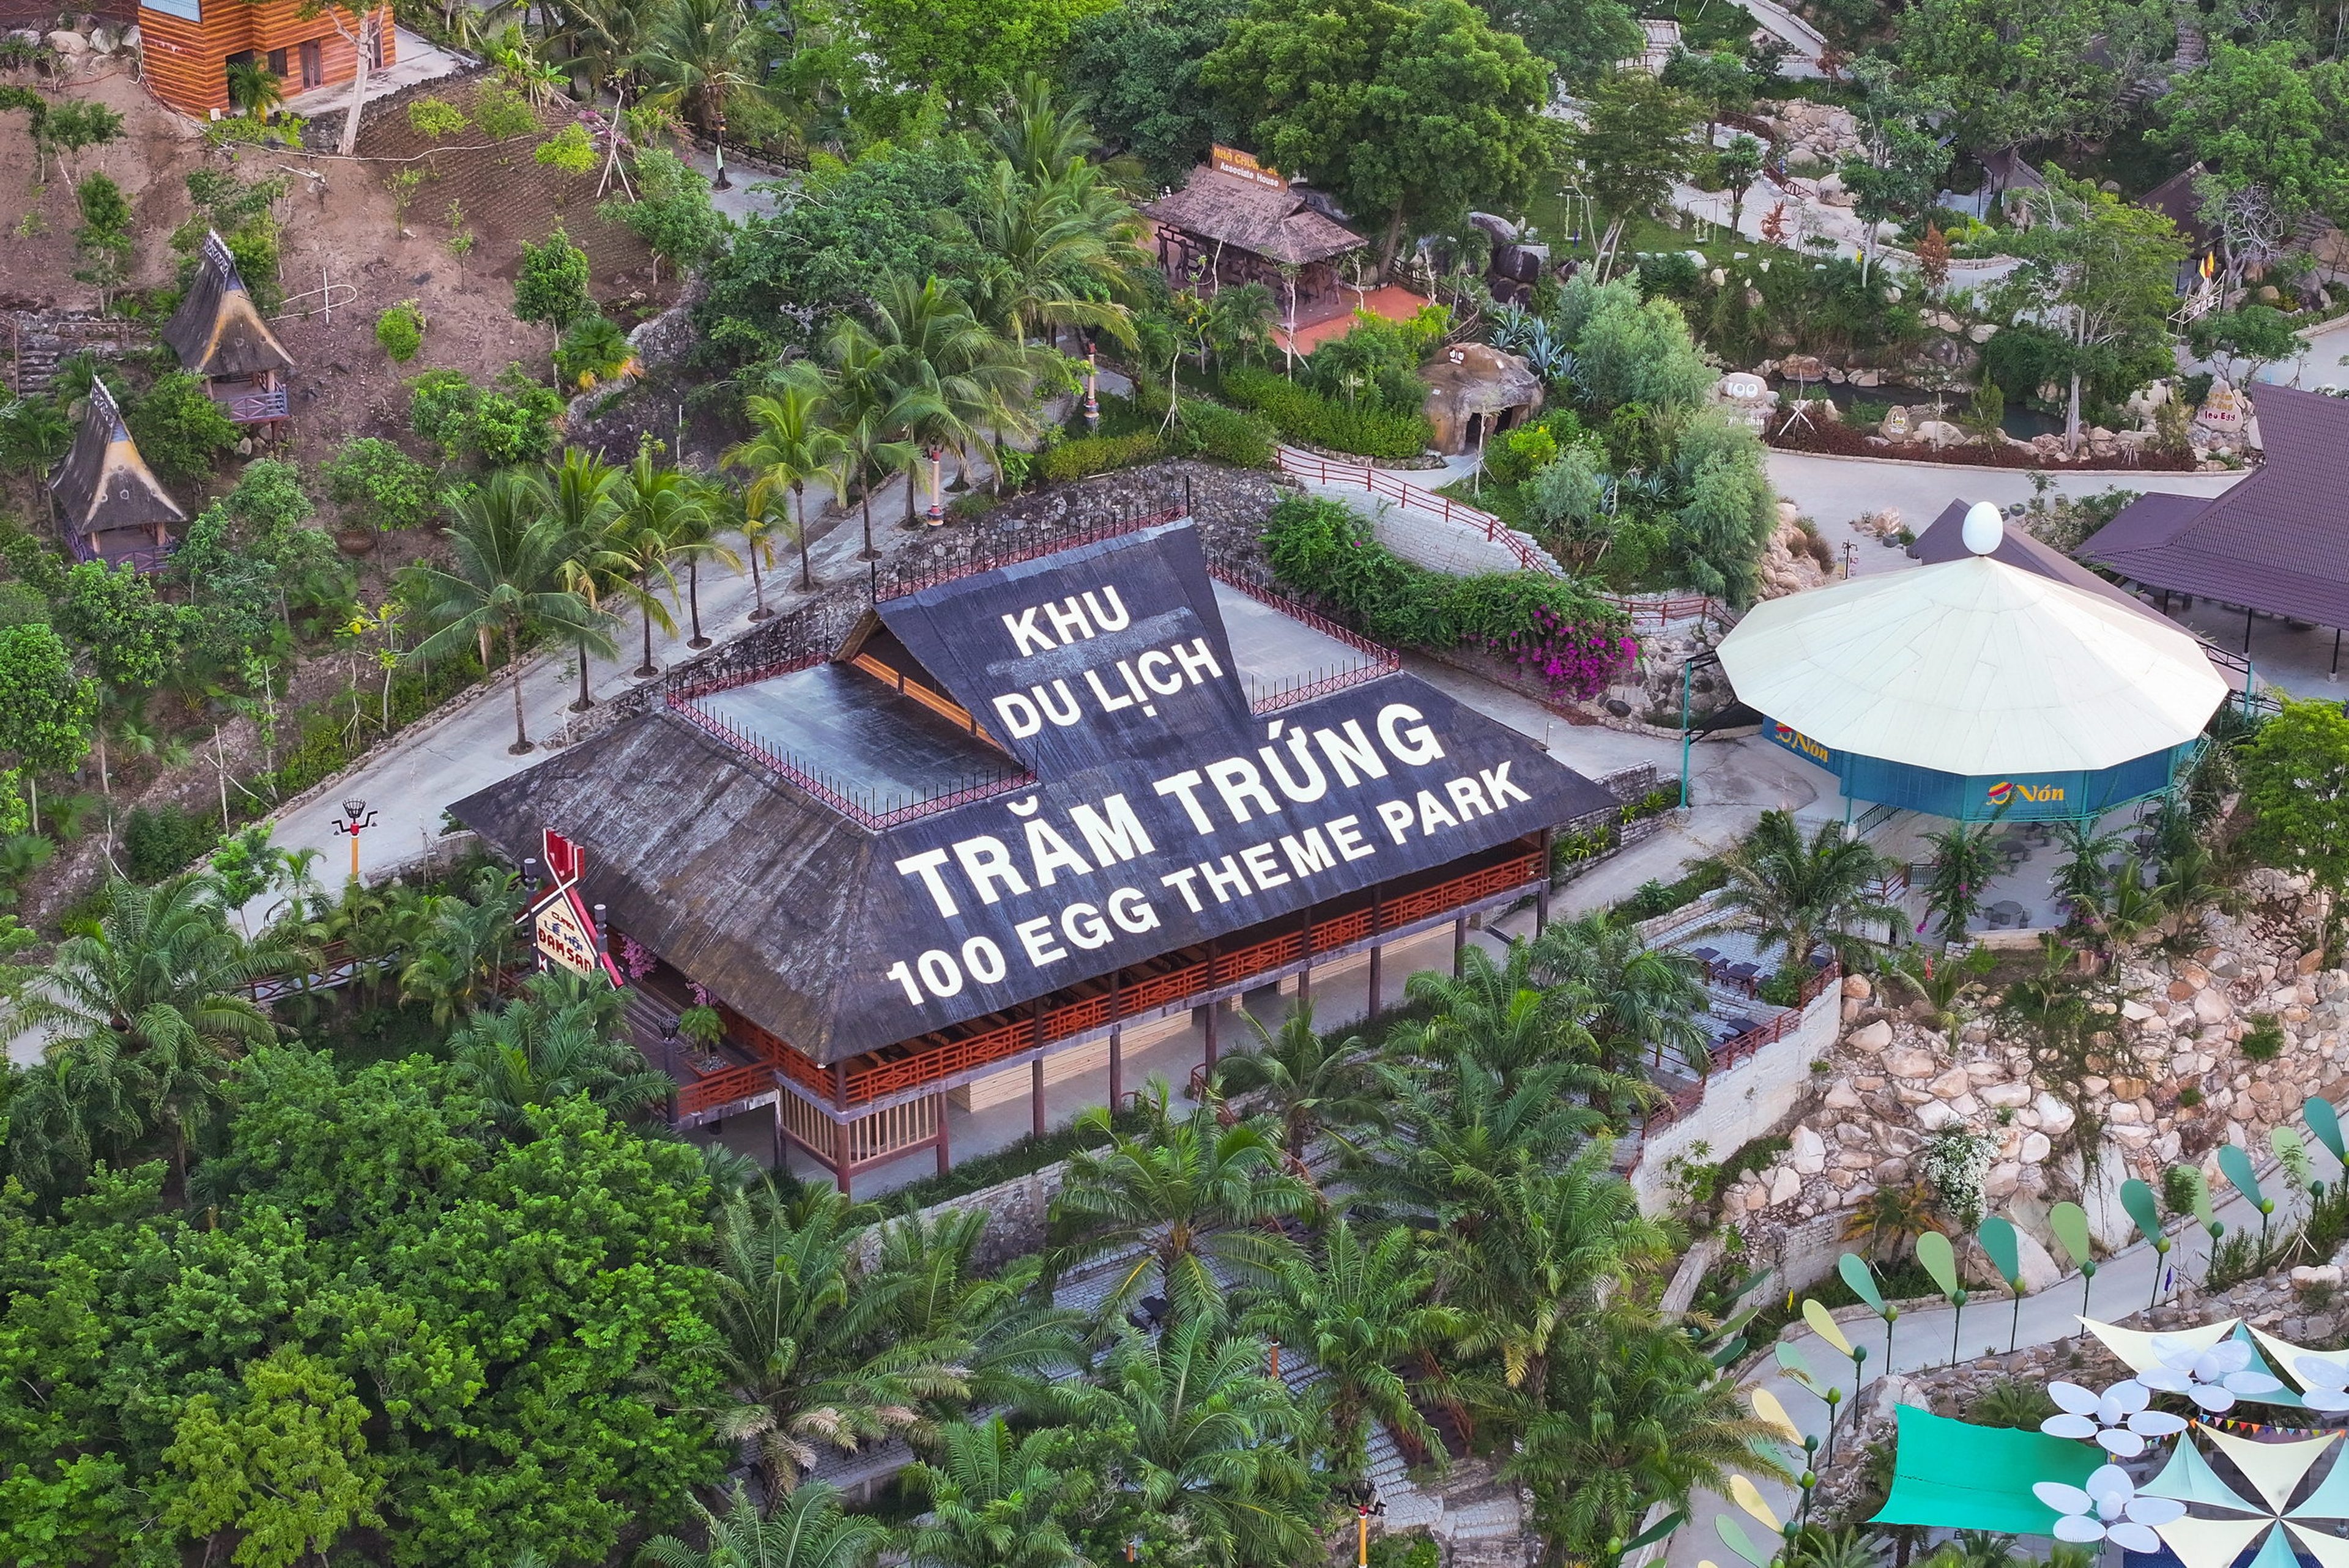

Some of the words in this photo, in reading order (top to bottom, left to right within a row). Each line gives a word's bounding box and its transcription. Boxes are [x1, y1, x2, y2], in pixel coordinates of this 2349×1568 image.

[1220, 161, 1254, 179] Associate
[1256, 172, 1279, 187] House
[2220, 412, 2236, 421] Egg
[1001, 585, 1130, 657] KHU
[992, 679, 1082, 739] DU
[1083, 638, 1223, 717] LỊCH
[895, 793, 1156, 918] TRĂM
[1153, 704, 1445, 835] TRỨNG
[886, 937, 1006, 1005] 100
[1014, 888, 1160, 967] EGG
[1160, 815, 1375, 913] THEME
[1376, 761, 1531, 845] PARK
